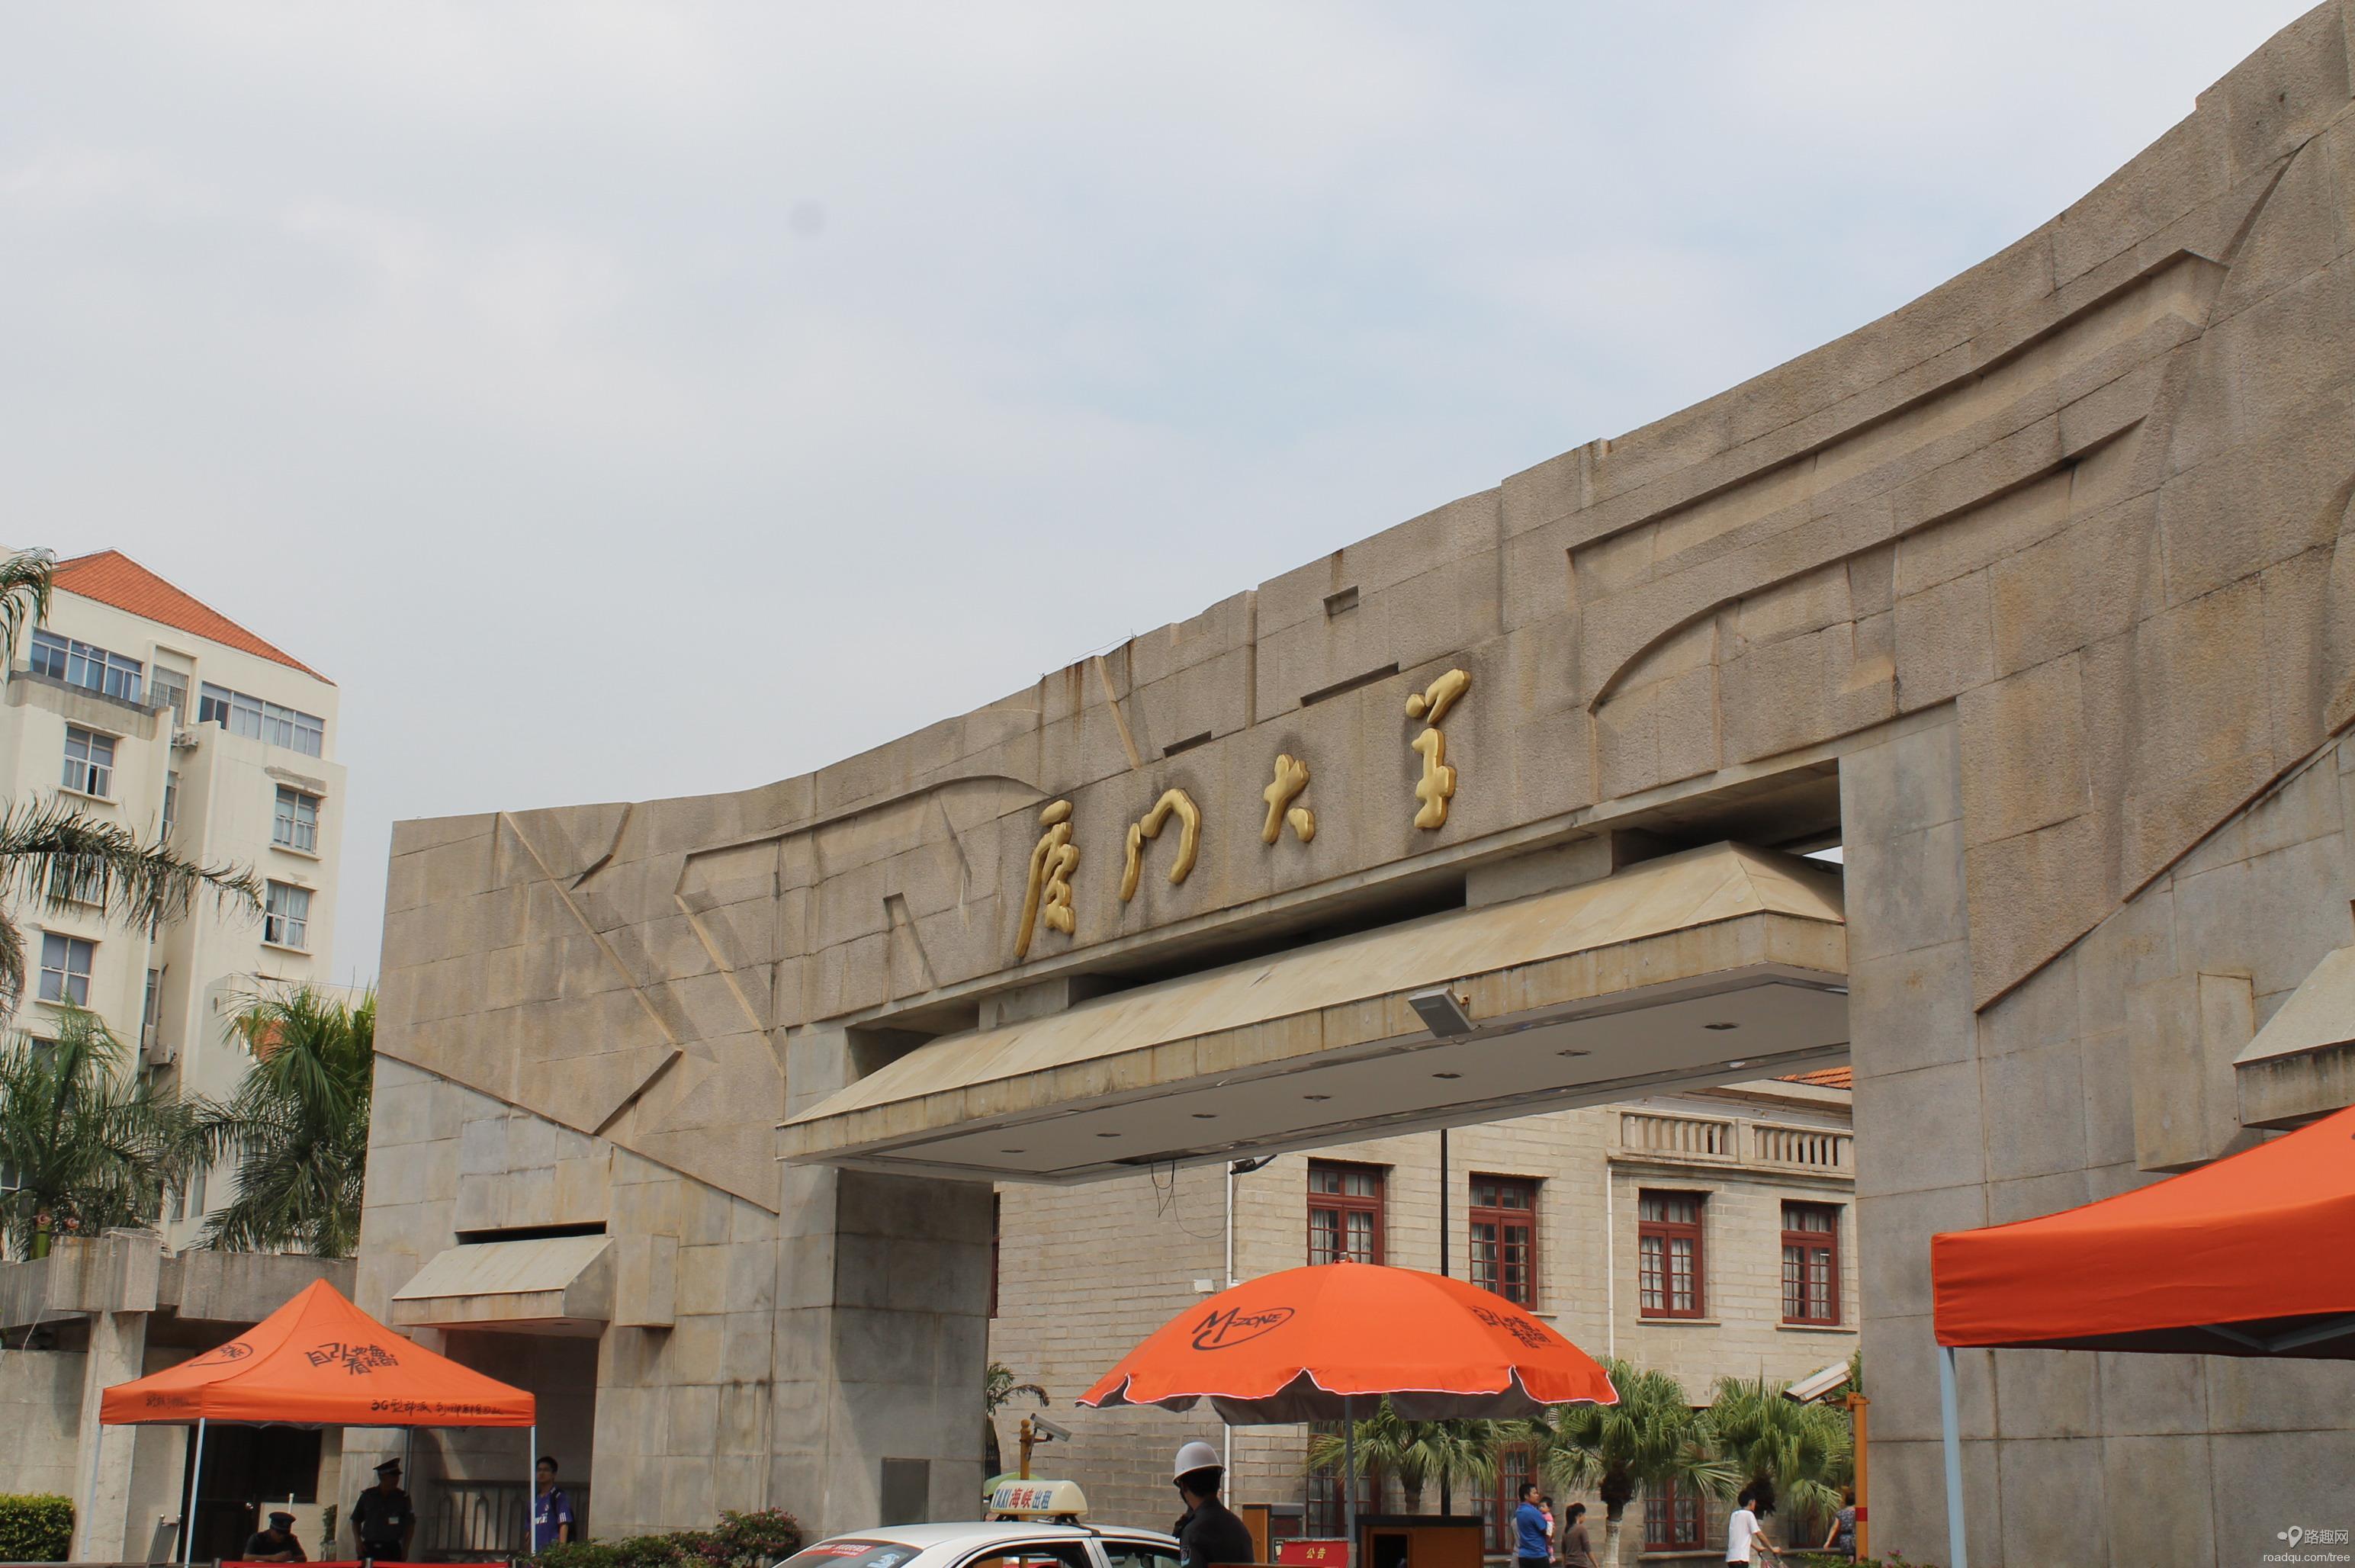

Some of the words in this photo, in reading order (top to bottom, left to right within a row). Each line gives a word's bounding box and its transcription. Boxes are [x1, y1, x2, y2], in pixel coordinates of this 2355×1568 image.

[992, 1488, 1012, 1509] TAXI
[1009, 1487, 1052, 1509] 海峡出租
[1306, 1547, 1327, 1560] 公告
